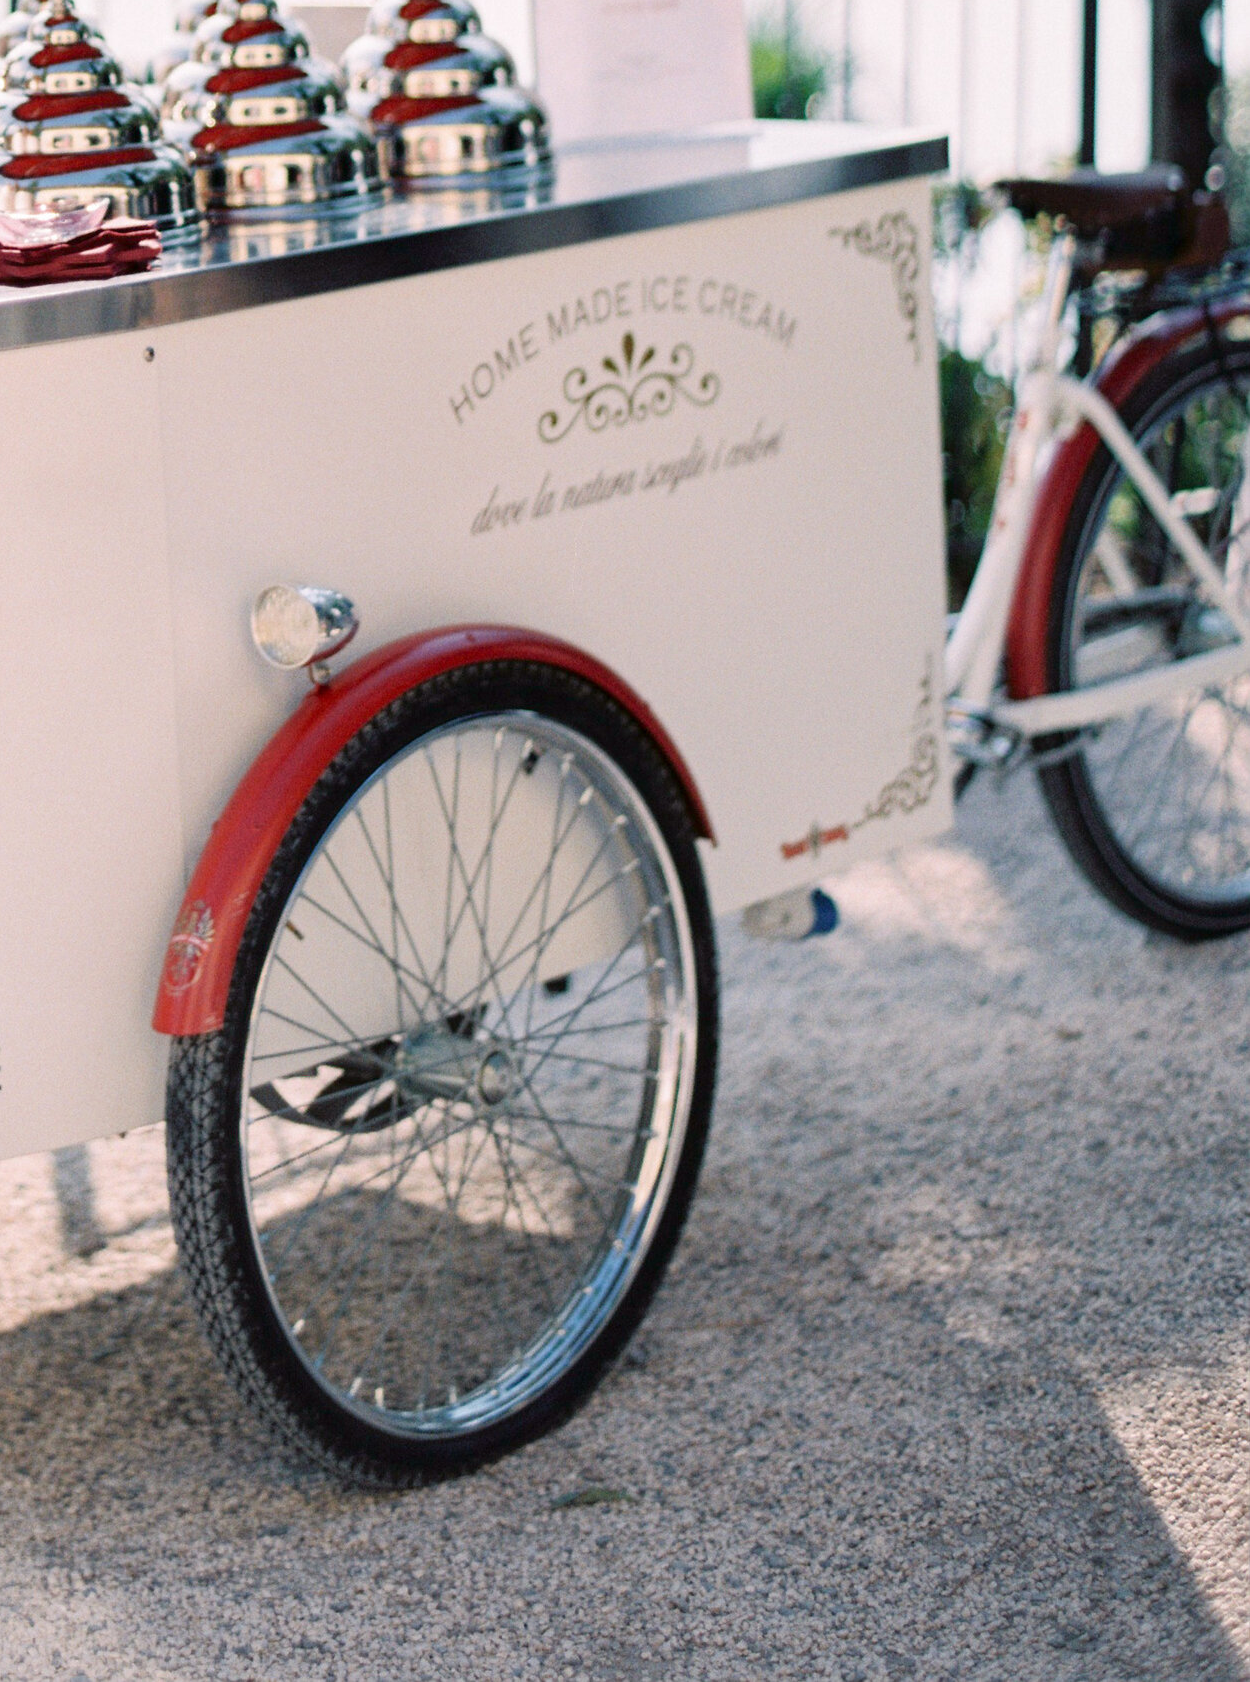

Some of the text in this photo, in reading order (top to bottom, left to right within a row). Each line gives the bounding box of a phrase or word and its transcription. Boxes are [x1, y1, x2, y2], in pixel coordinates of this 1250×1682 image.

[450, 276, 797, 425] HOME MADE ICE CREAM
